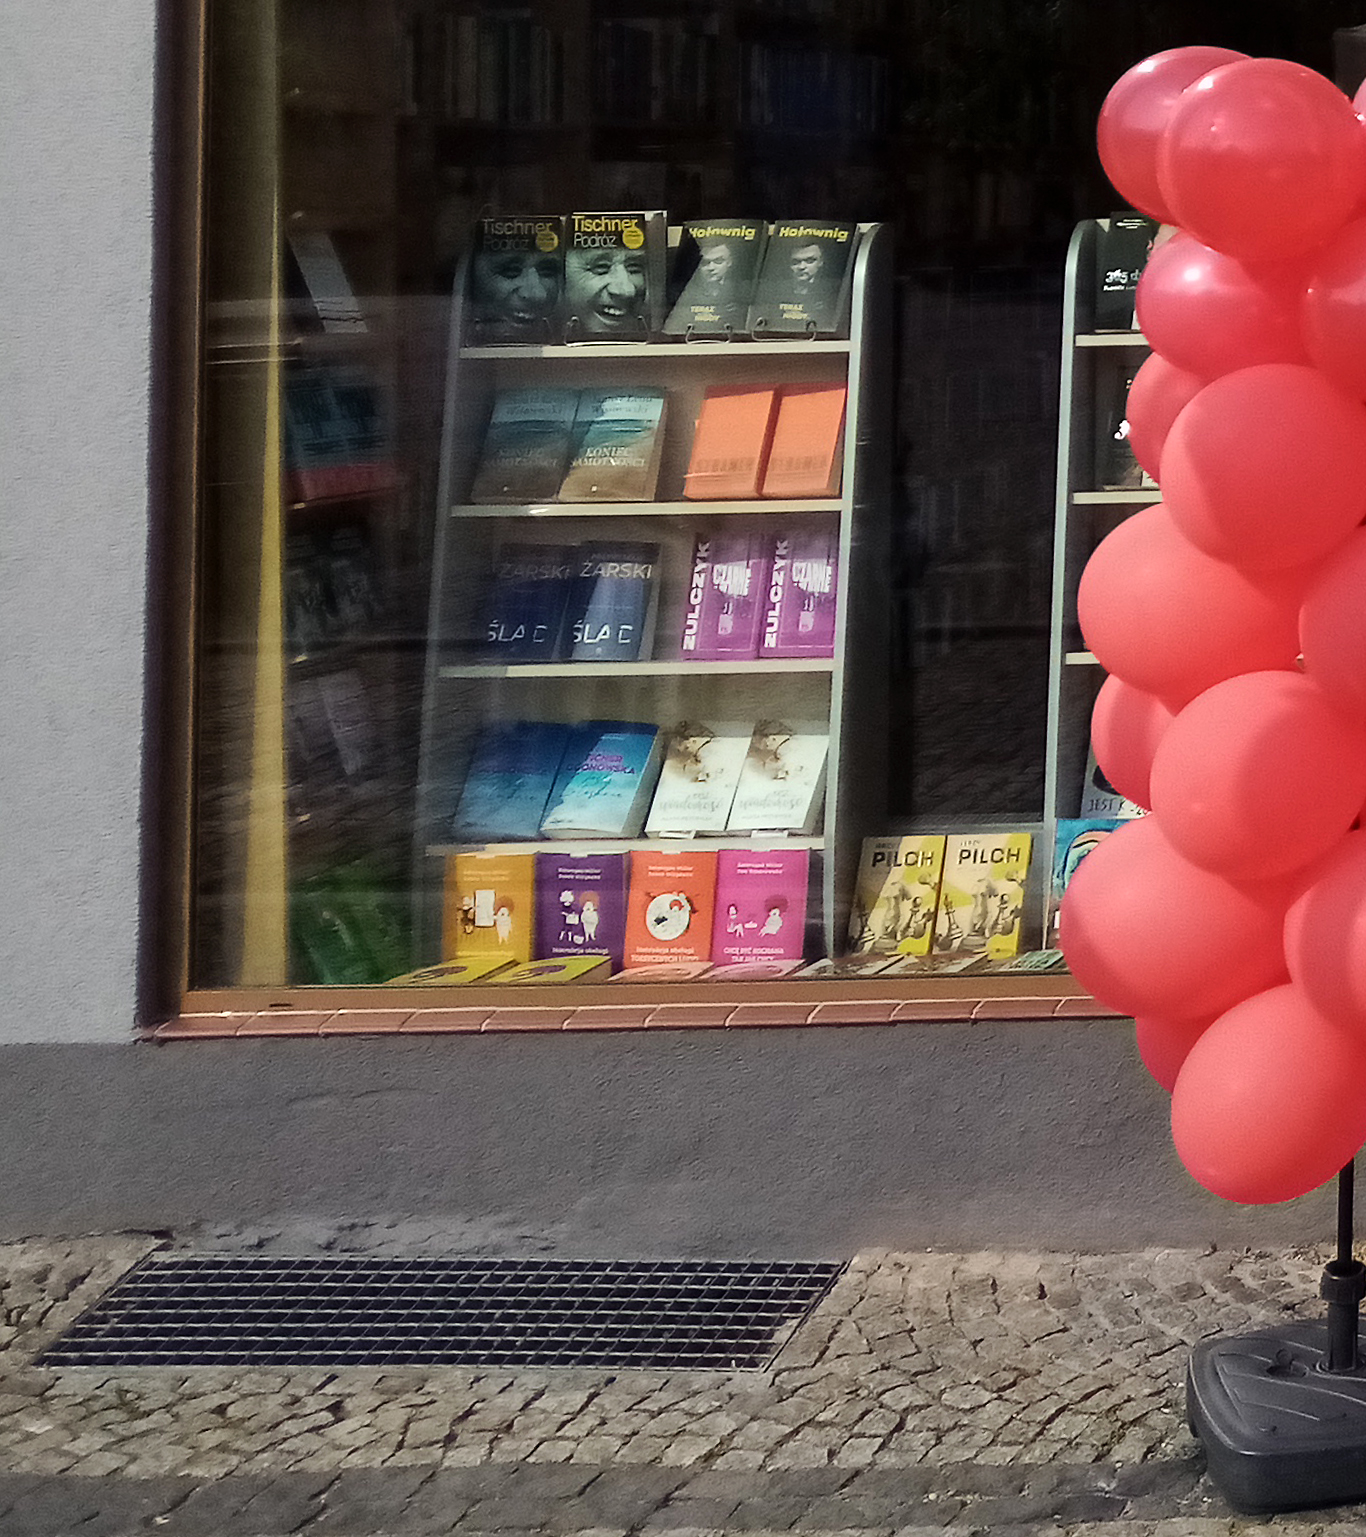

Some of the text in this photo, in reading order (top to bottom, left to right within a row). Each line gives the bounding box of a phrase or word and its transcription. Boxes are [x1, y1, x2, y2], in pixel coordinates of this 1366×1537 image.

[572, 215, 638, 232] Tischner
[579, 560, 653, 580] ŻARSKI
[872, 850, 935, 868] PILCH
[958, 847, 1021, 865] PILCH
